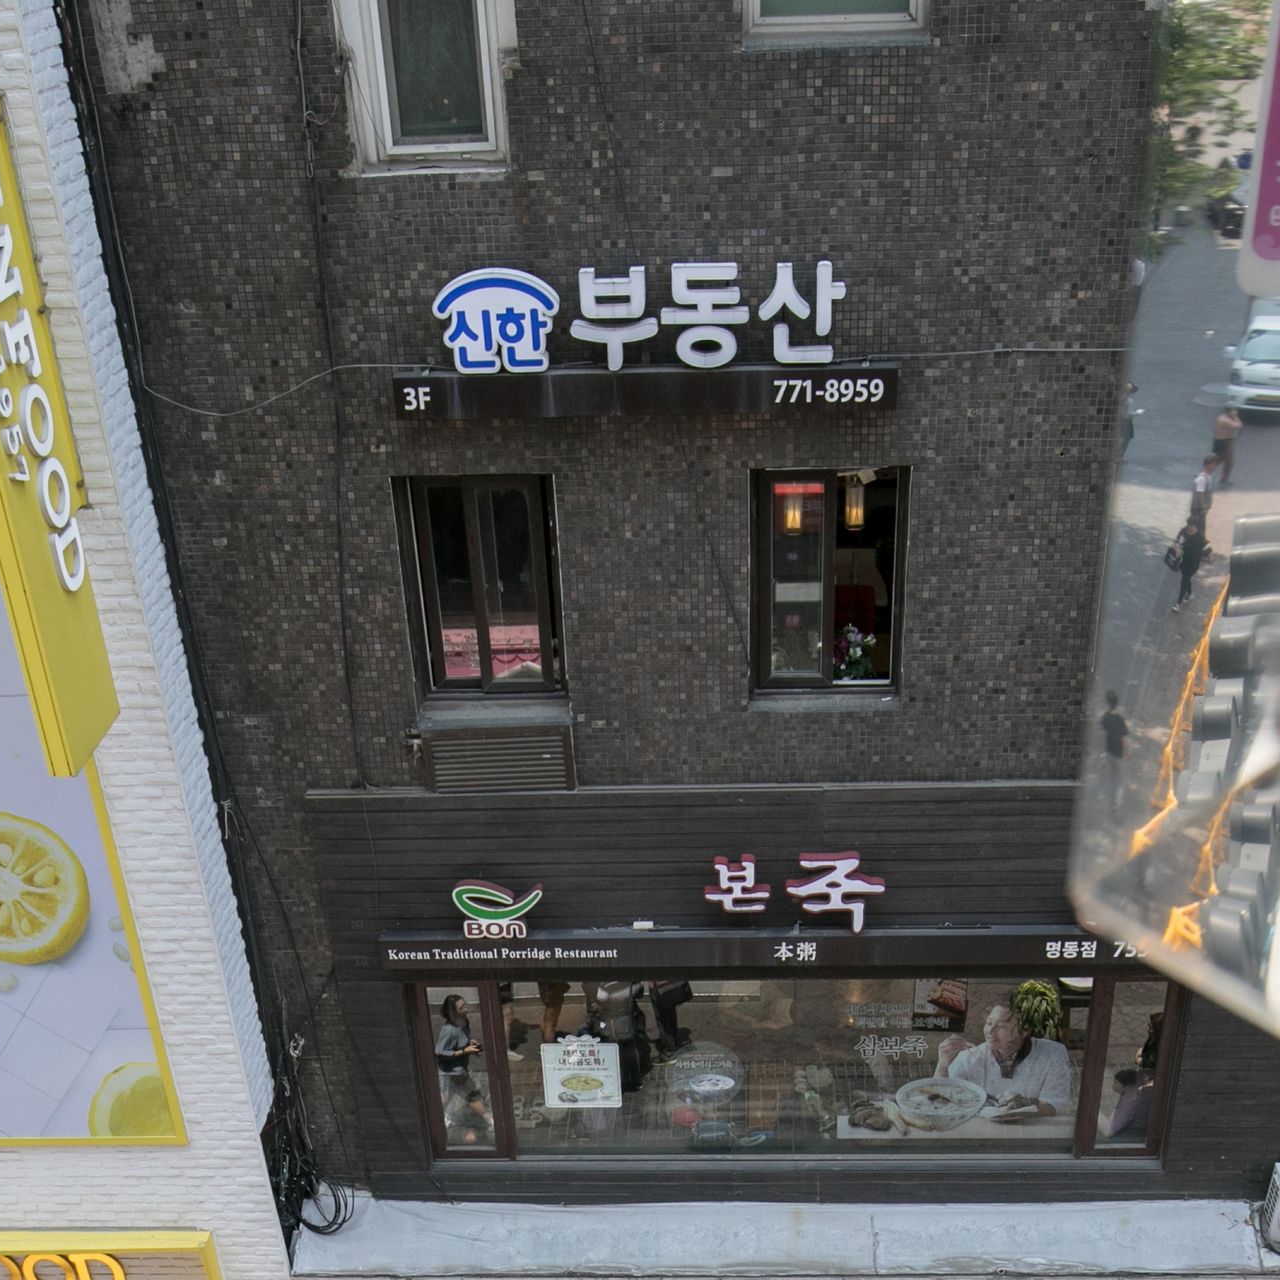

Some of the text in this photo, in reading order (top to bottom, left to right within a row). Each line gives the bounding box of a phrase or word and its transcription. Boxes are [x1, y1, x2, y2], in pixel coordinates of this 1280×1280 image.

[448, 260, 845, 370] 신한 부동산
[403, 386, 431, 411] 3F
[773, 378, 885, 404] 771-8959
[704, 850, 886, 934] 본죽
[388, 948, 618, 960] Korean Traditional Porridge Restaurant
[773, 940, 817, 962] 本粥
[1046, 941, 1148, 958] 명동점 75
[854, 1034, 928, 1060] 삼복죽
